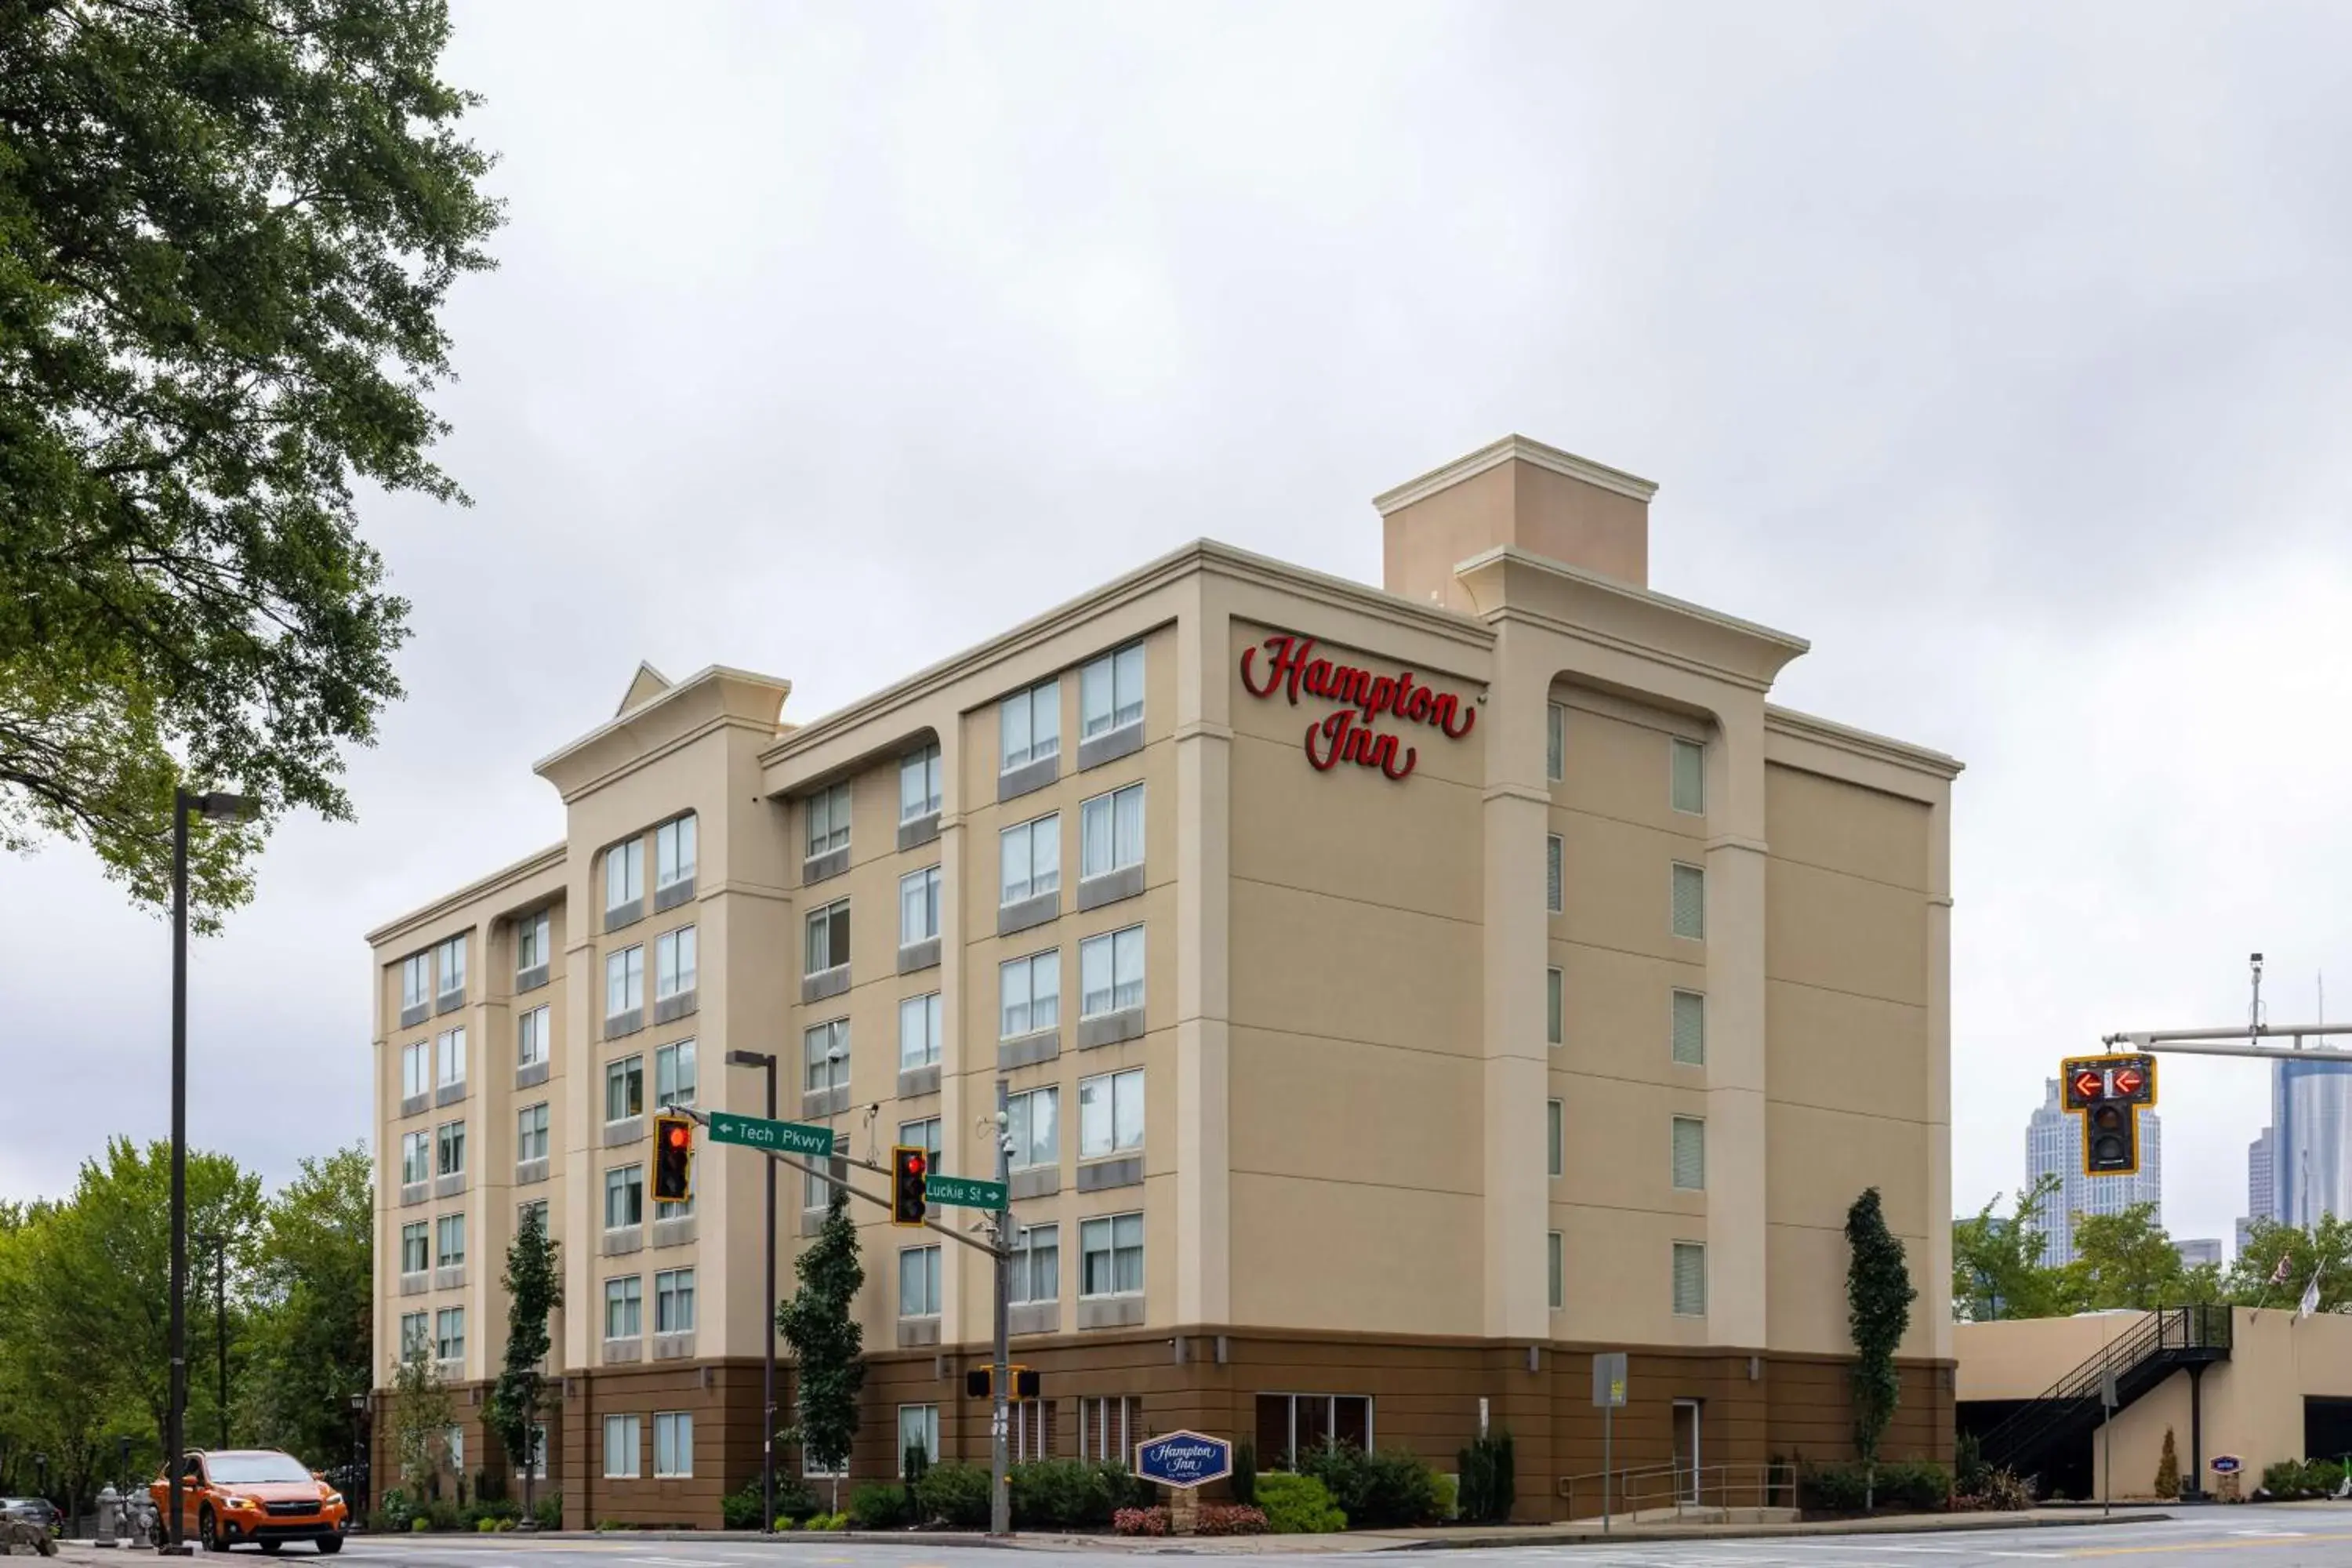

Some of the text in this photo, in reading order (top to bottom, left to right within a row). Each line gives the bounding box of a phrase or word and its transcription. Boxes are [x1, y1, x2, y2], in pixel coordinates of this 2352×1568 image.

[1240, 636, 1475, 739] Hampton
[1305, 710, 1416, 780] Inn
[738, 1123, 826, 1152] Tech Pkwy
[926, 1181, 982, 1201] Luckie St
[1150, 1443, 1216, 1462] Hampton
[1166, 1457, 1202, 1472] Inn
